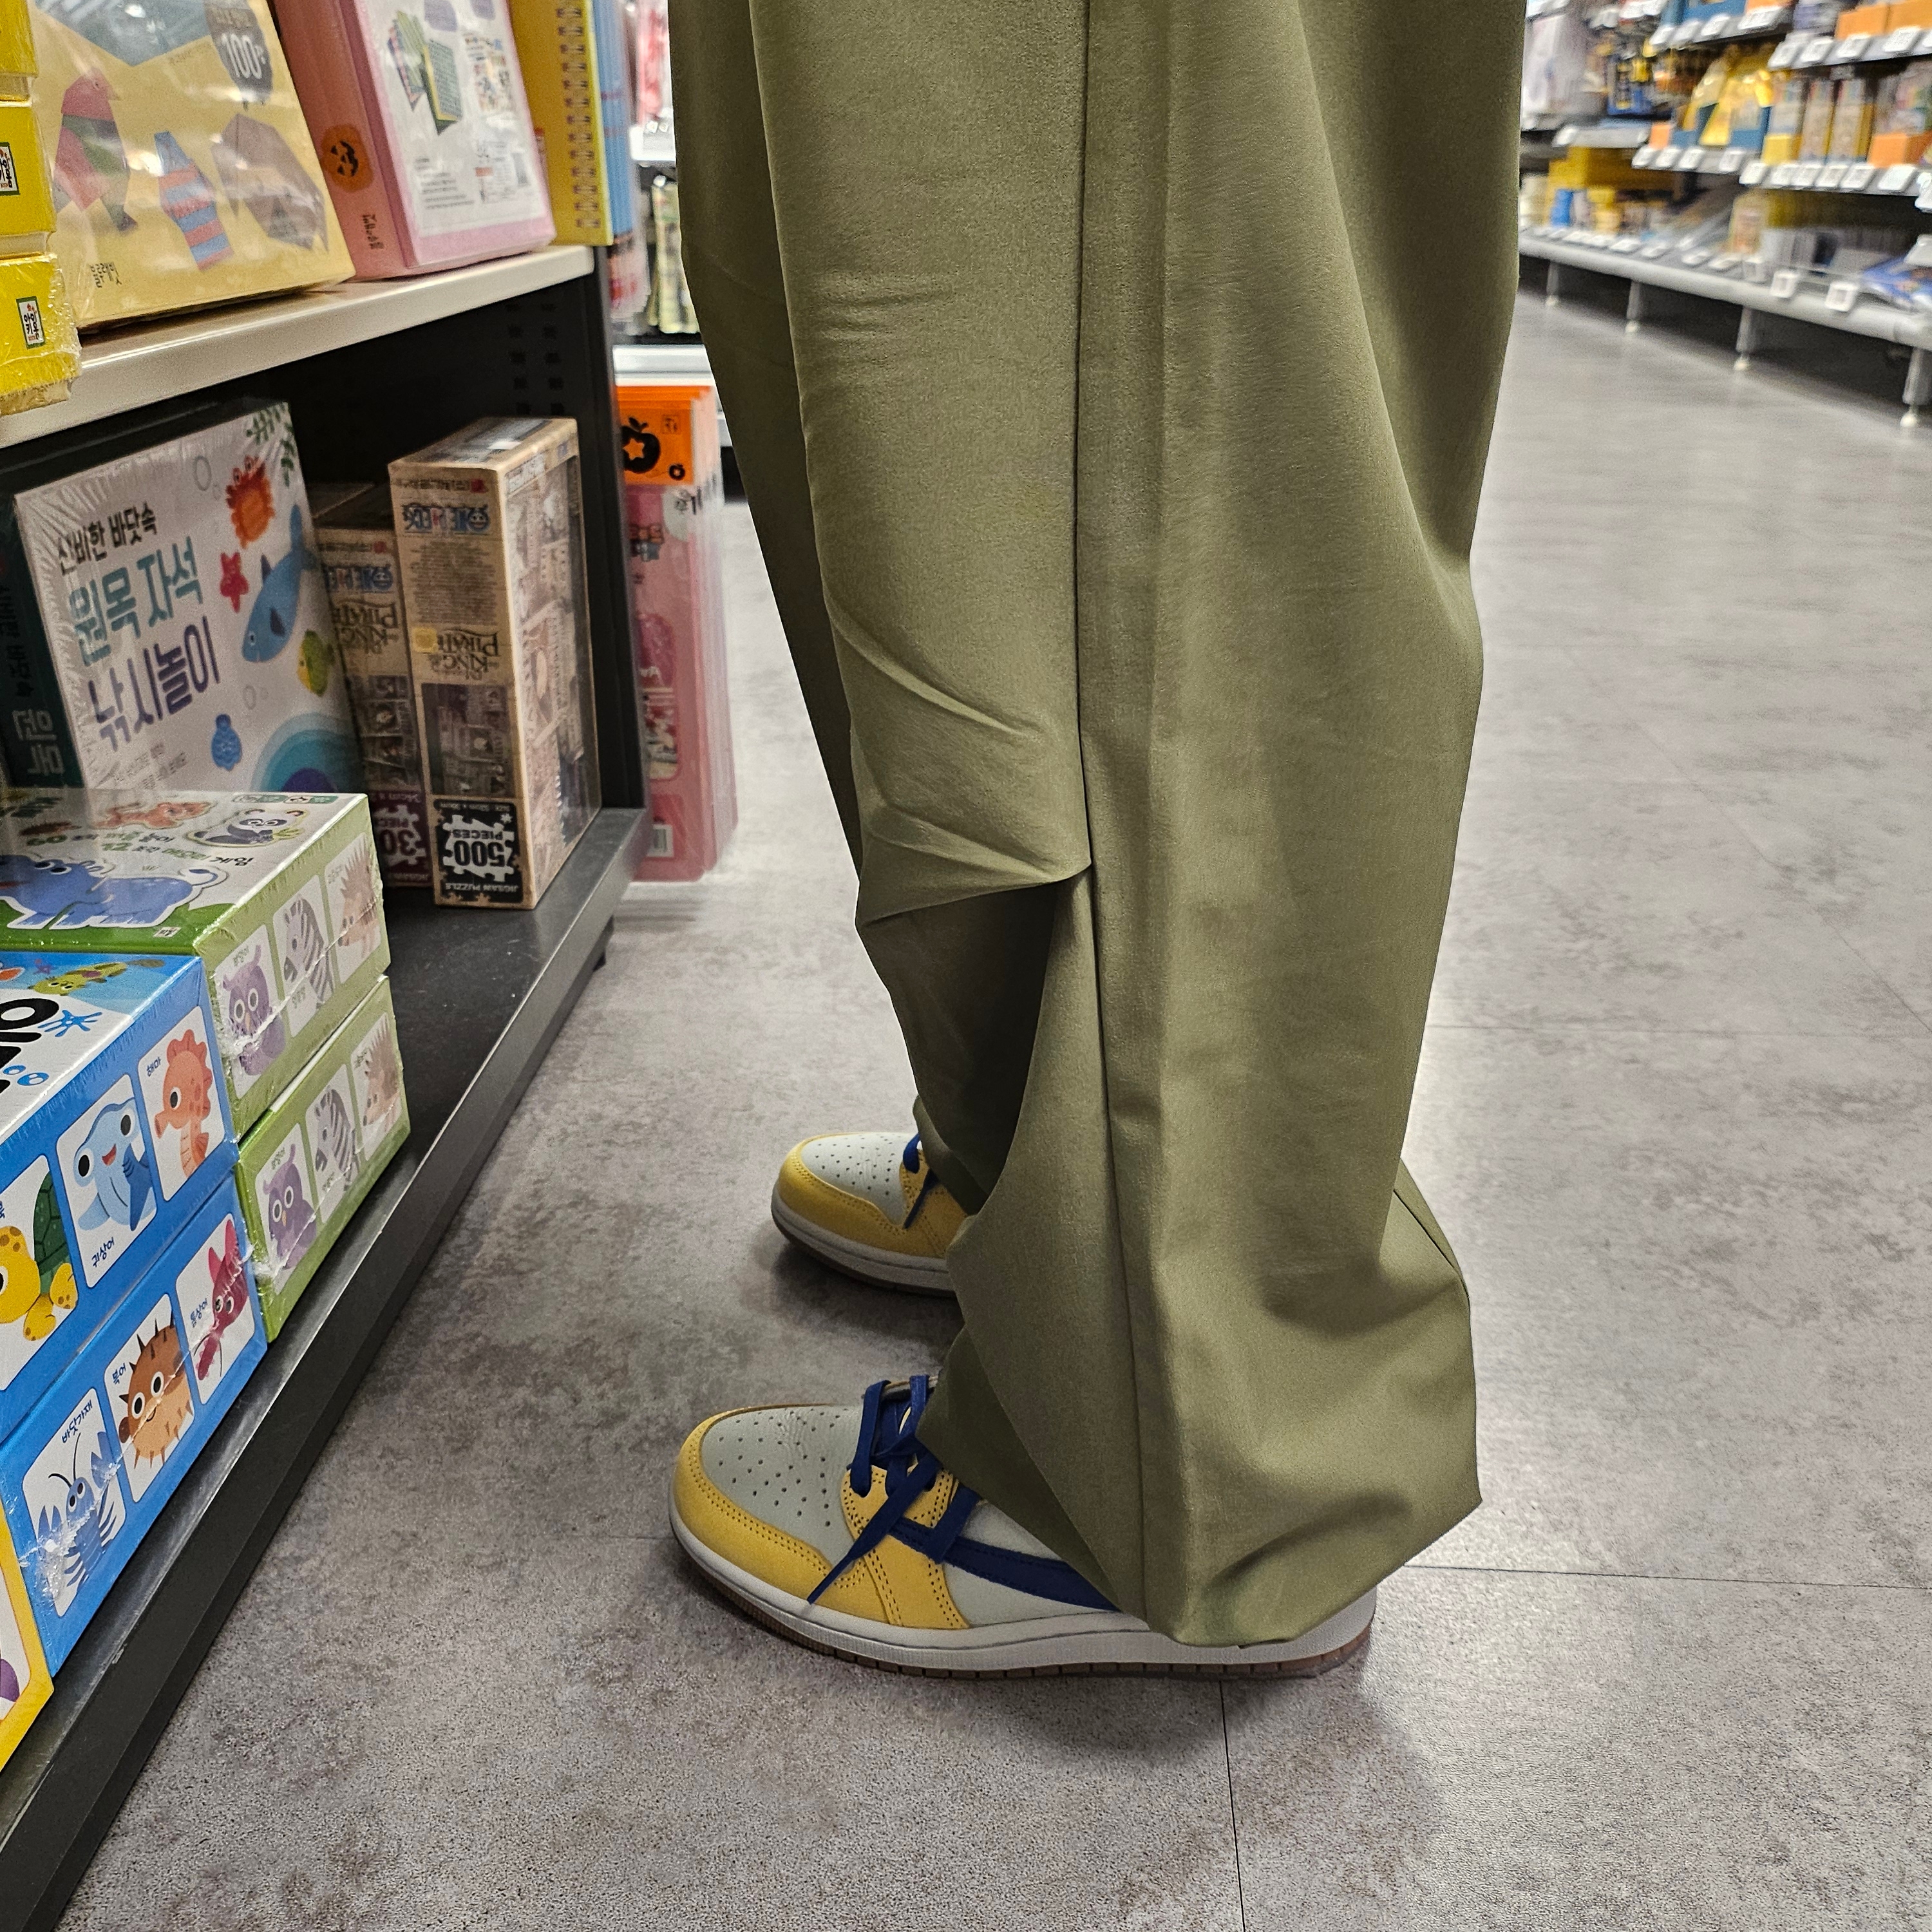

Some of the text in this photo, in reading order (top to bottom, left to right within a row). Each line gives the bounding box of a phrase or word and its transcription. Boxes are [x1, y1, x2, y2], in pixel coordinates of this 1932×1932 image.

[59, 500, 157, 576] 신비한 바닷속
[68, 536, 204, 667] 원목 자석
[88, 616, 220, 752] 낚시놀이
[453, 829, 503, 840] PIECES
[453, 840, 506, 867] 500
[444, 882, 518, 893] JIGSAW PUZZLE
[146, 1056, 162, 1077] 해마
[91, 1236, 115, 1268] 귀상어
[112, 1362, 127, 1385] 복어
[61, 1399, 93, 1443] 바닷가재
